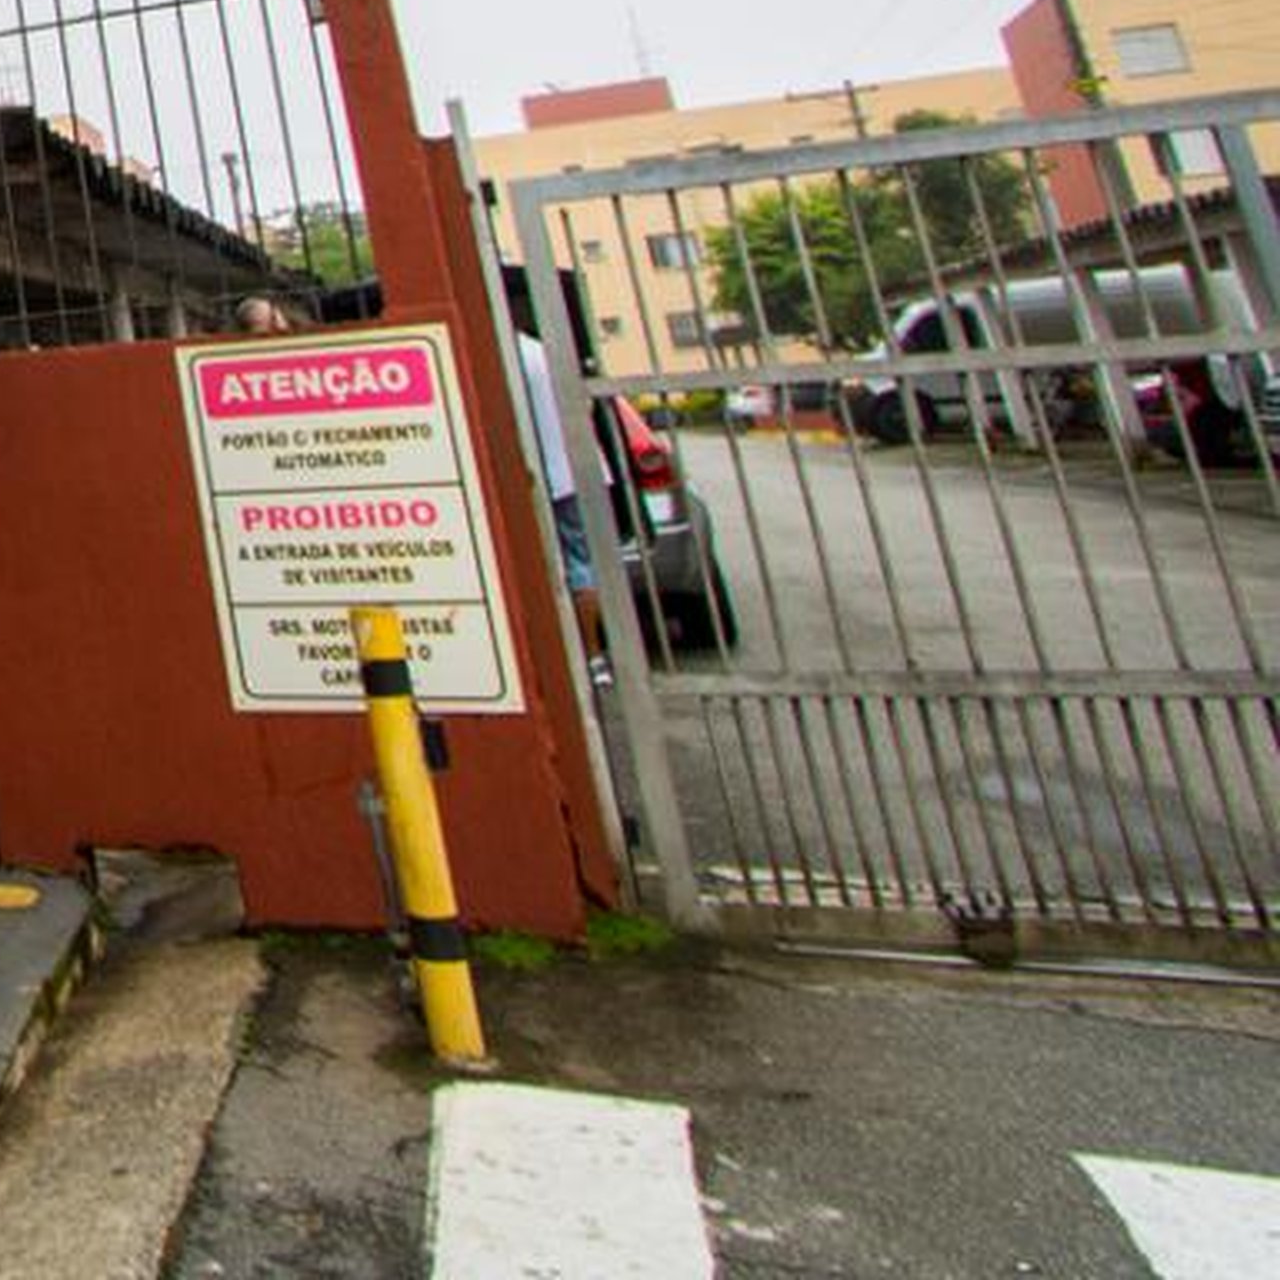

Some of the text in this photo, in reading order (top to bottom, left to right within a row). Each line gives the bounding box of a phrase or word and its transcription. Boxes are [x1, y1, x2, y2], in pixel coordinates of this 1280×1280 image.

[220, 357, 411, 405] ATENÇÃO
[313, 423, 433, 446] FECHAMENTO
[241, 500, 439, 533] PROIBIDO
[239, 545, 251, 561] A
[253, 542, 332, 561] ENTRADA
[337, 539, 361, 559] DE
[282, 565, 415, 586] DE VISITANTES
